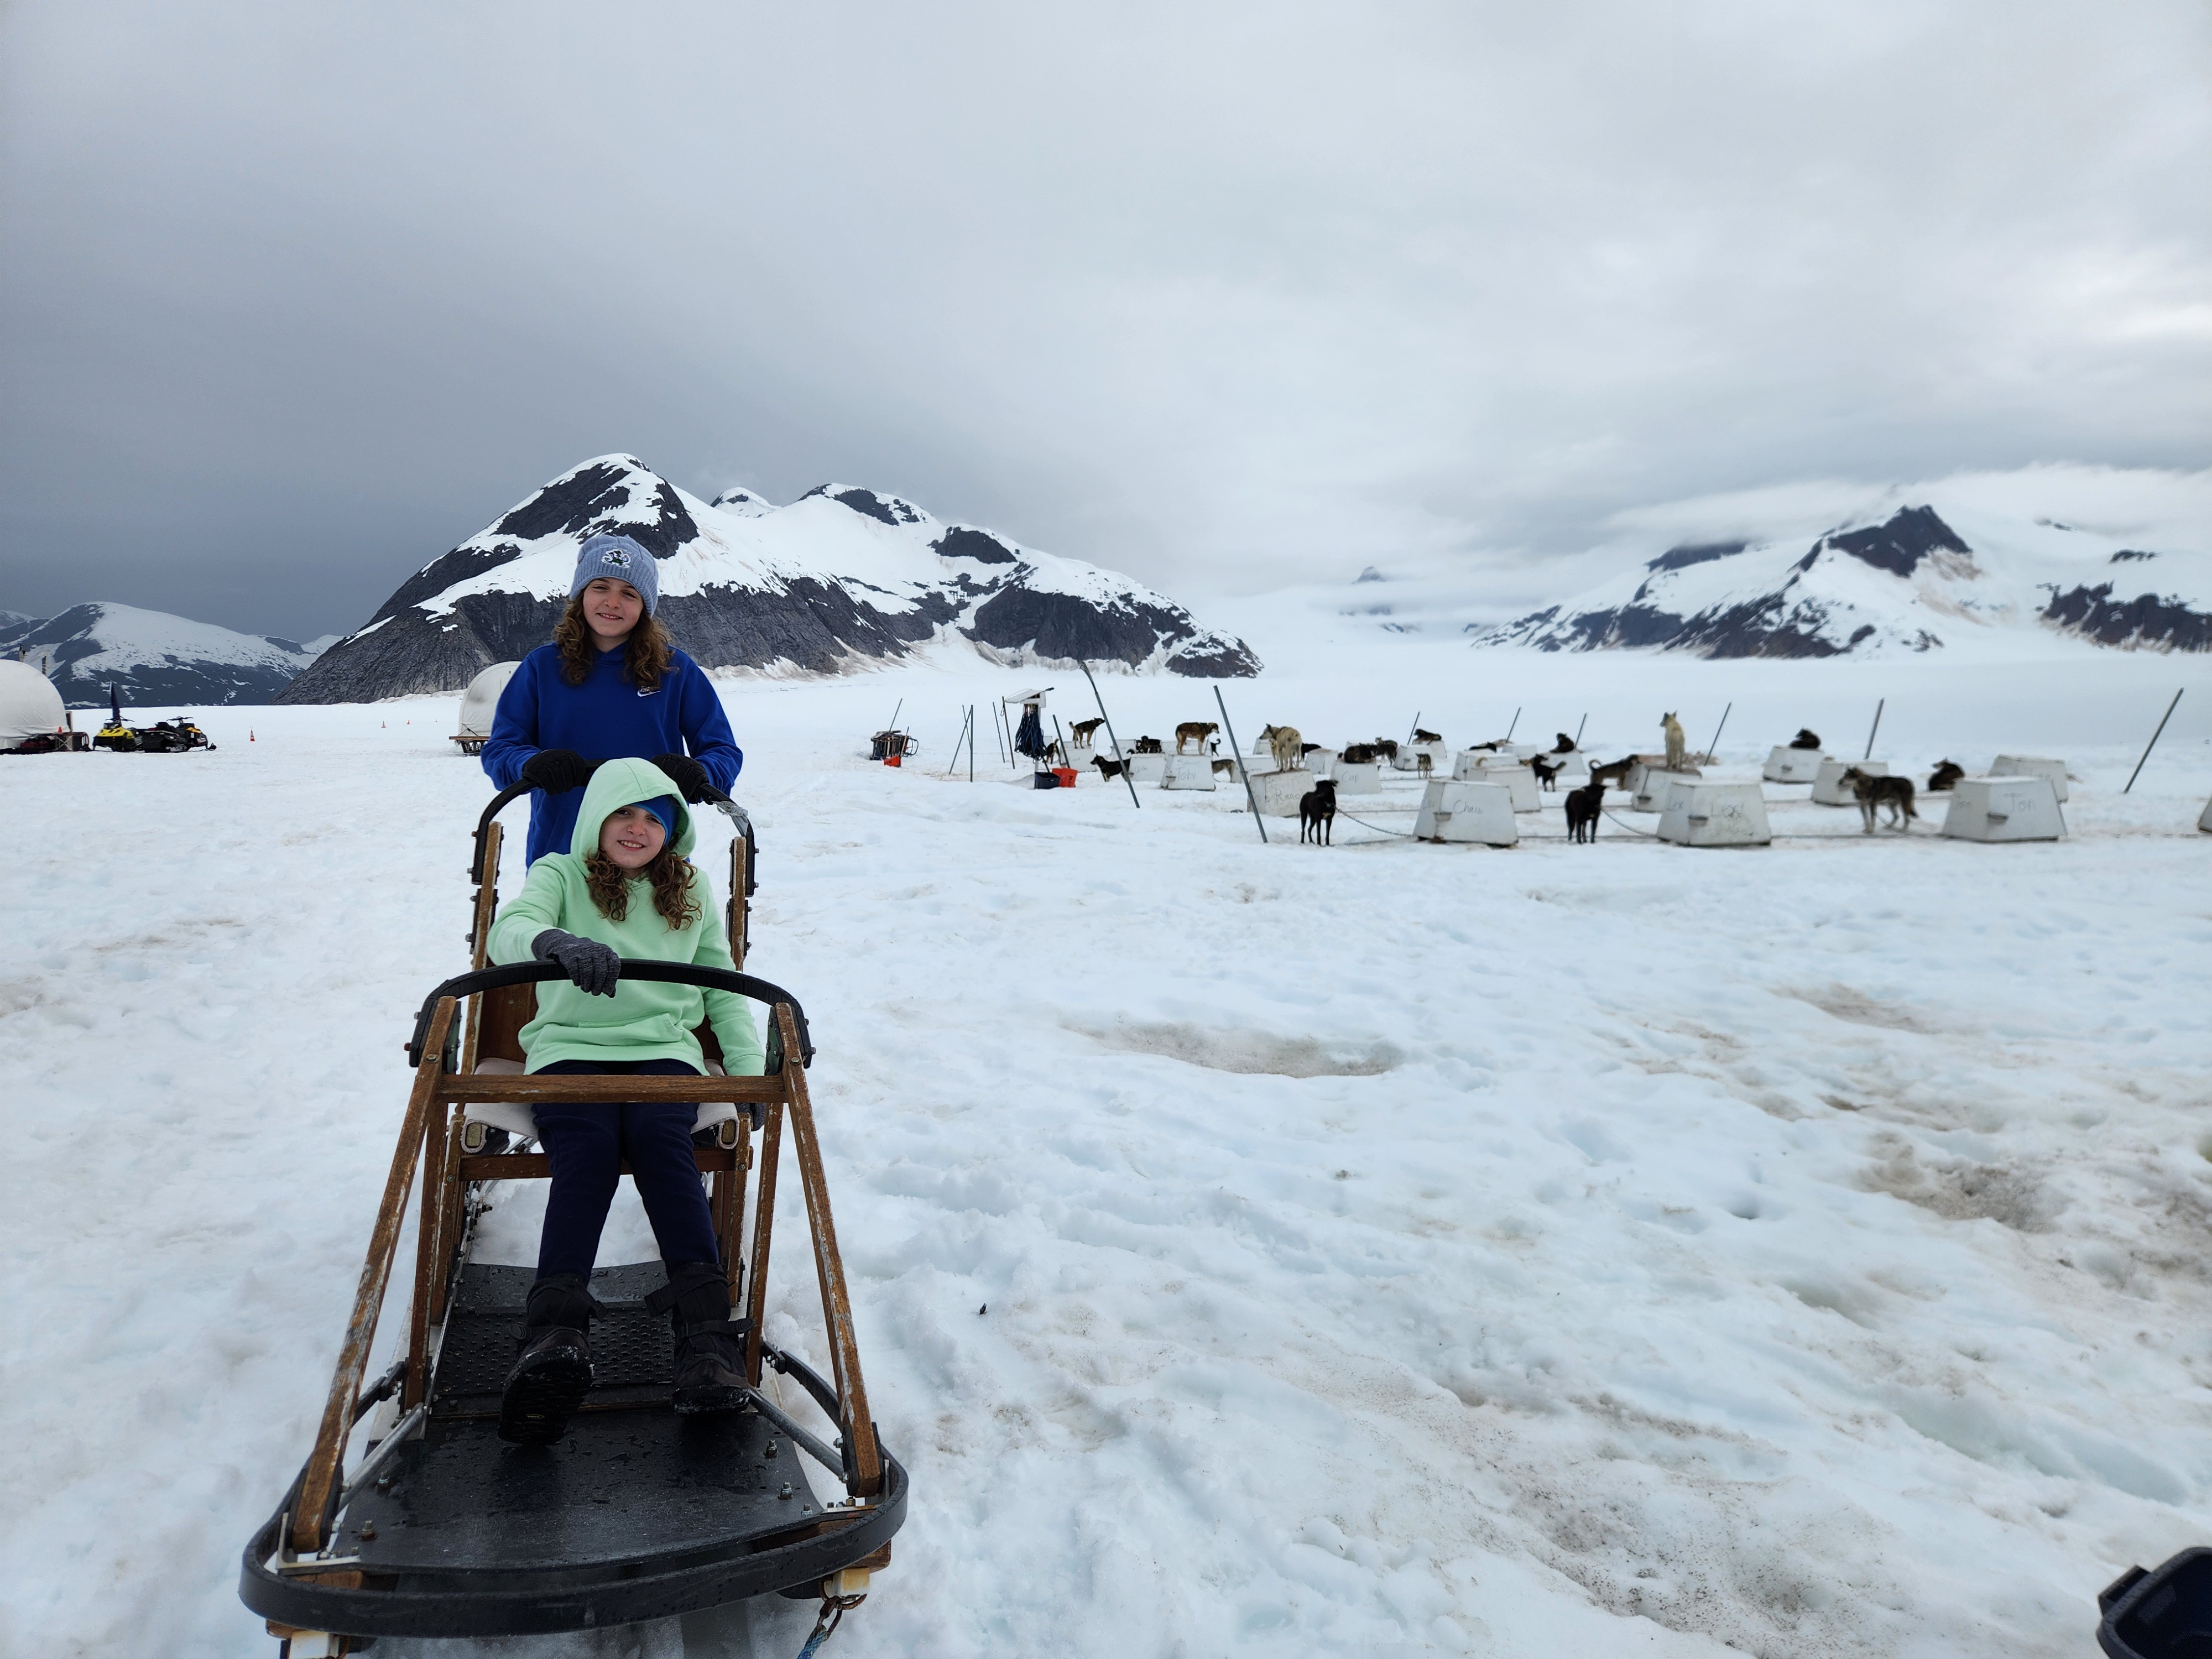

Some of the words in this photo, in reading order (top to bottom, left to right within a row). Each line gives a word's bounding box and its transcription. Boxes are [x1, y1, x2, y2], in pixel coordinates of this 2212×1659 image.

[1341, 770, 1359, 783] Cap
[1275, 788, 1301, 804] Reno
[1453, 799, 1483, 815] Chew
